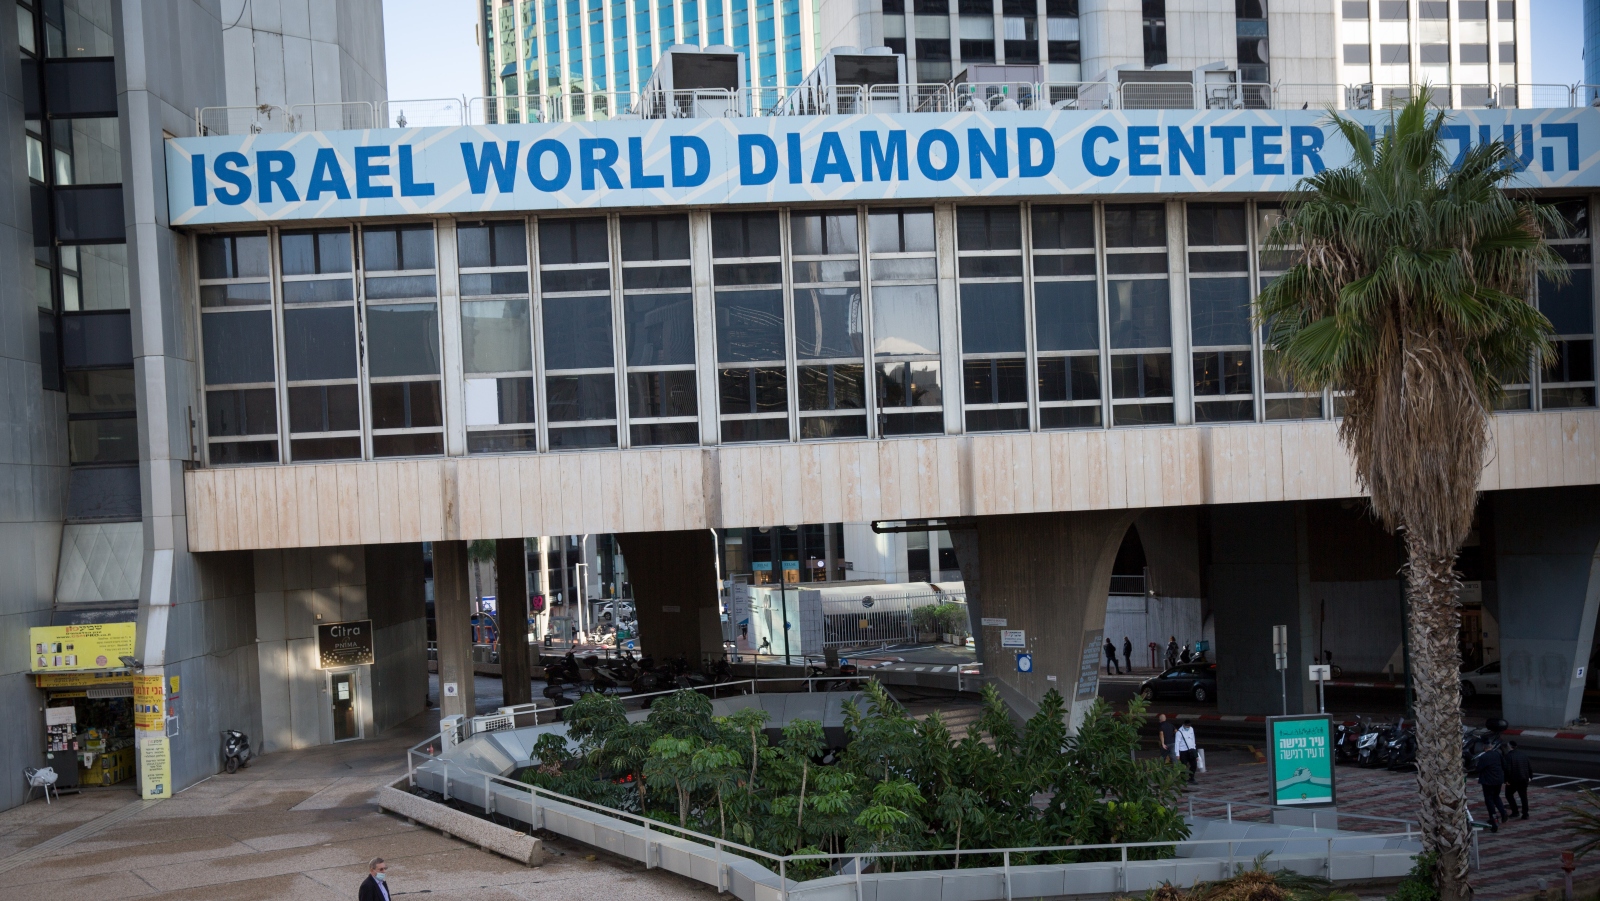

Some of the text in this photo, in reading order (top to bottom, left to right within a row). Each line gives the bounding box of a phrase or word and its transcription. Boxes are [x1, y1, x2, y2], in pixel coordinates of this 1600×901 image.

[191, 125, 1326, 207] ISRAEL WORLD DIAMOND CENTER
[330, 625, 361, 637] Citra
[1280, 736, 1325, 748] עיר נגישה
[1280, 748, 1304, 760] רגישה
[1304, 748, 1317, 758] עיר
